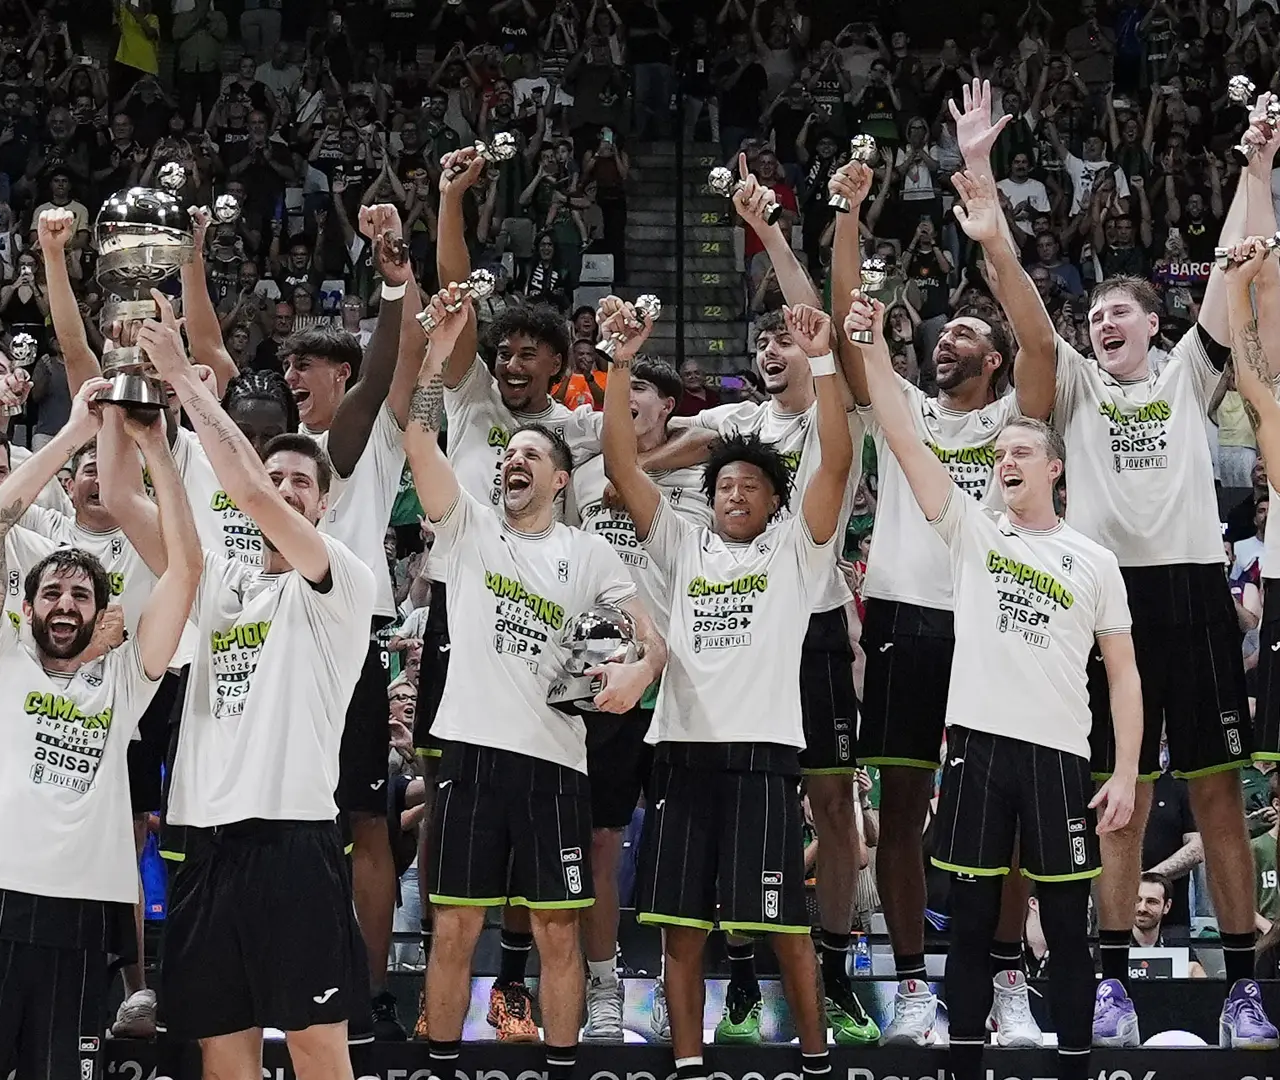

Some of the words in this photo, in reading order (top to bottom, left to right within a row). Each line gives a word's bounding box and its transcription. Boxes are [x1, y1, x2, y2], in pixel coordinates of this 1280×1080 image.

[701, 212, 719, 223] 25
[702, 242, 720, 253] 24
[702, 273, 720, 284] 23
[705, 306, 722, 316] 22
[708, 339, 724, 351] 21
[598, 521, 634, 531] BADAL
[224, 535, 261, 551] asis
[604, 532, 638, 548] sisa
[986, 550, 1074, 610] CAMPIONS
[704, 635, 746, 646] JOVENTUT
[380, 651, 390, 670] 9
[36, 717, 108, 739] SUPERCOP
[1261, 870, 1277, 889] 19
